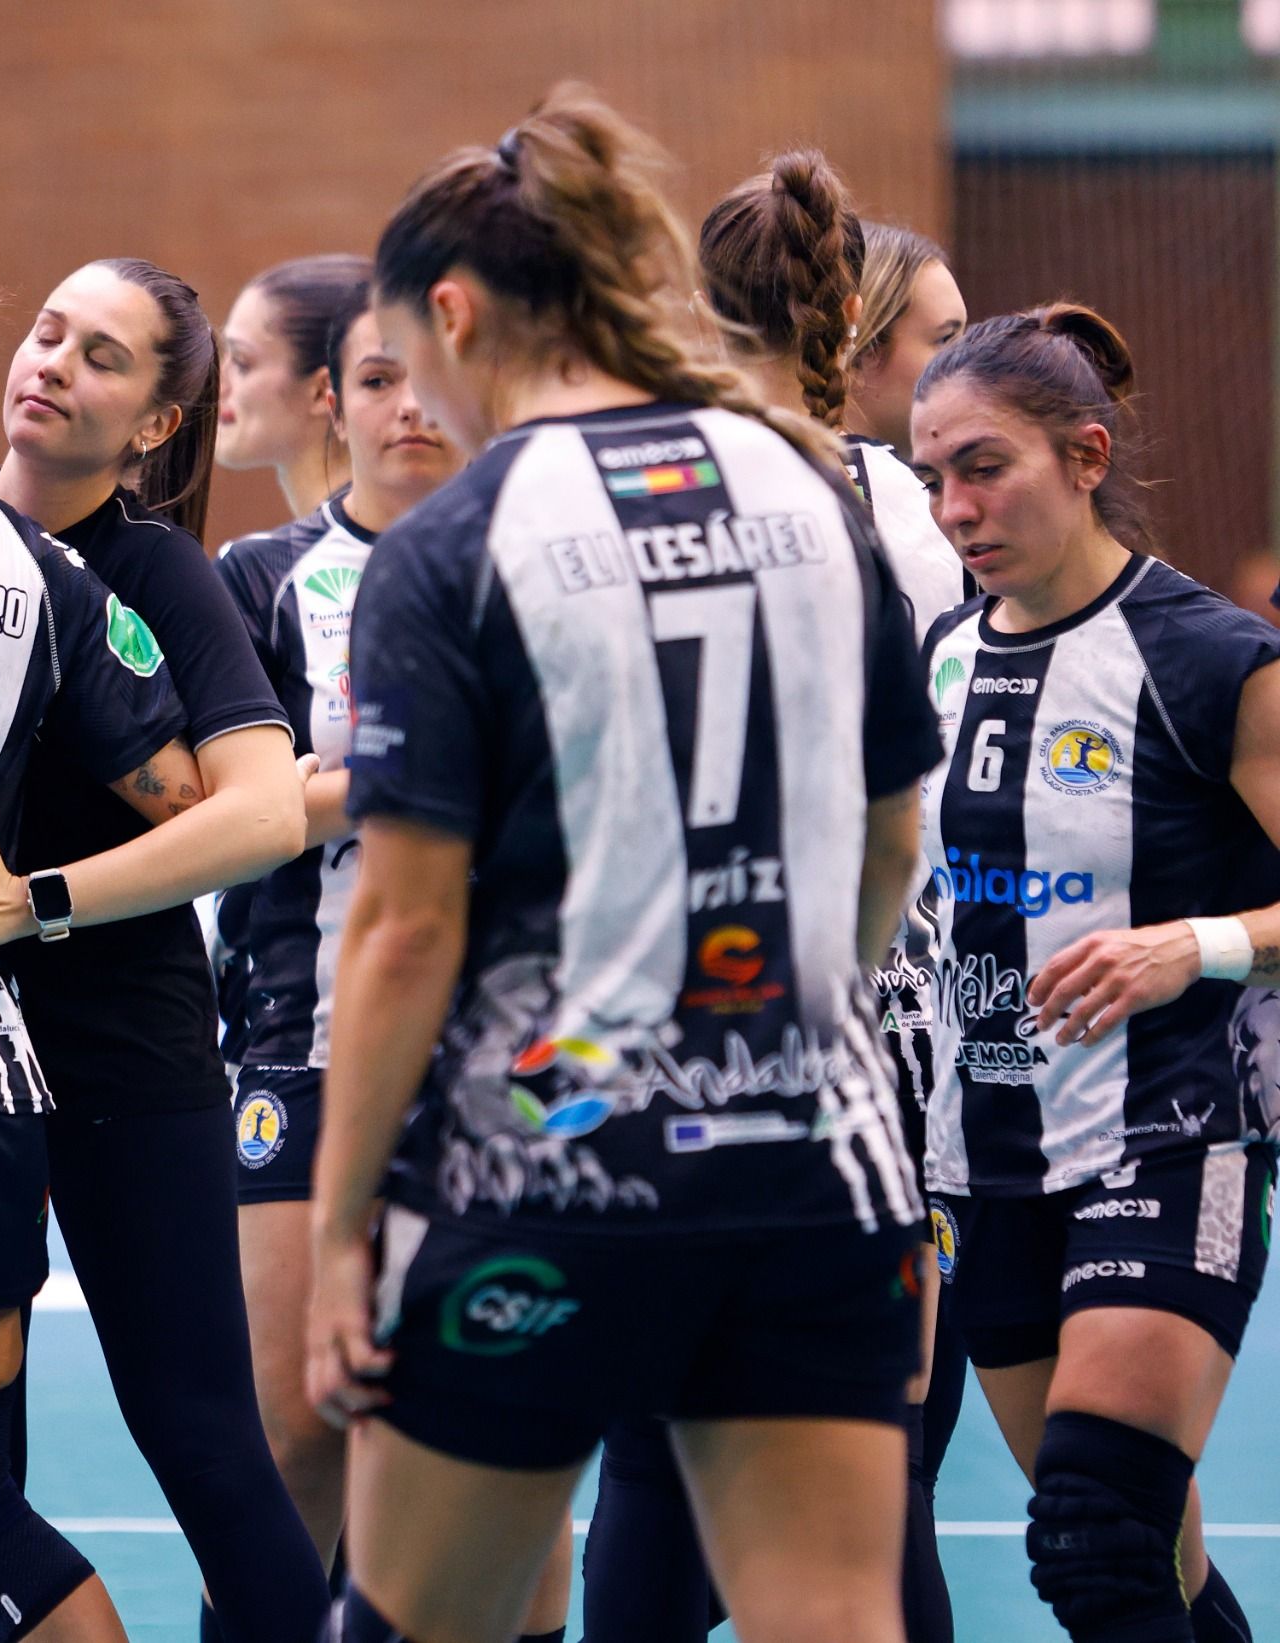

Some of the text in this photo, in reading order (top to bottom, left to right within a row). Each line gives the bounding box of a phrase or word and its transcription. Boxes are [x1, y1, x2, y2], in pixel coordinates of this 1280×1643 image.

[626, 507, 827, 583] CESÁREO
[650, 583, 759, 829] 7
[972, 677, 1021, 694] emec
[966, 719, 1007, 793] 6
[1039, 720, 1125, 765] CLUB BALONMANO FEMENINO
[1064, 788, 1094, 797] COSTA
[1094, 783, 1109, 794] DEL
[1108, 771, 1122, 785] SOL
[971, 1068, 1032, 1084] Talento Original
[979, 1043, 1050, 1068] MODA
[467, 1284, 582, 1335] CSIF
